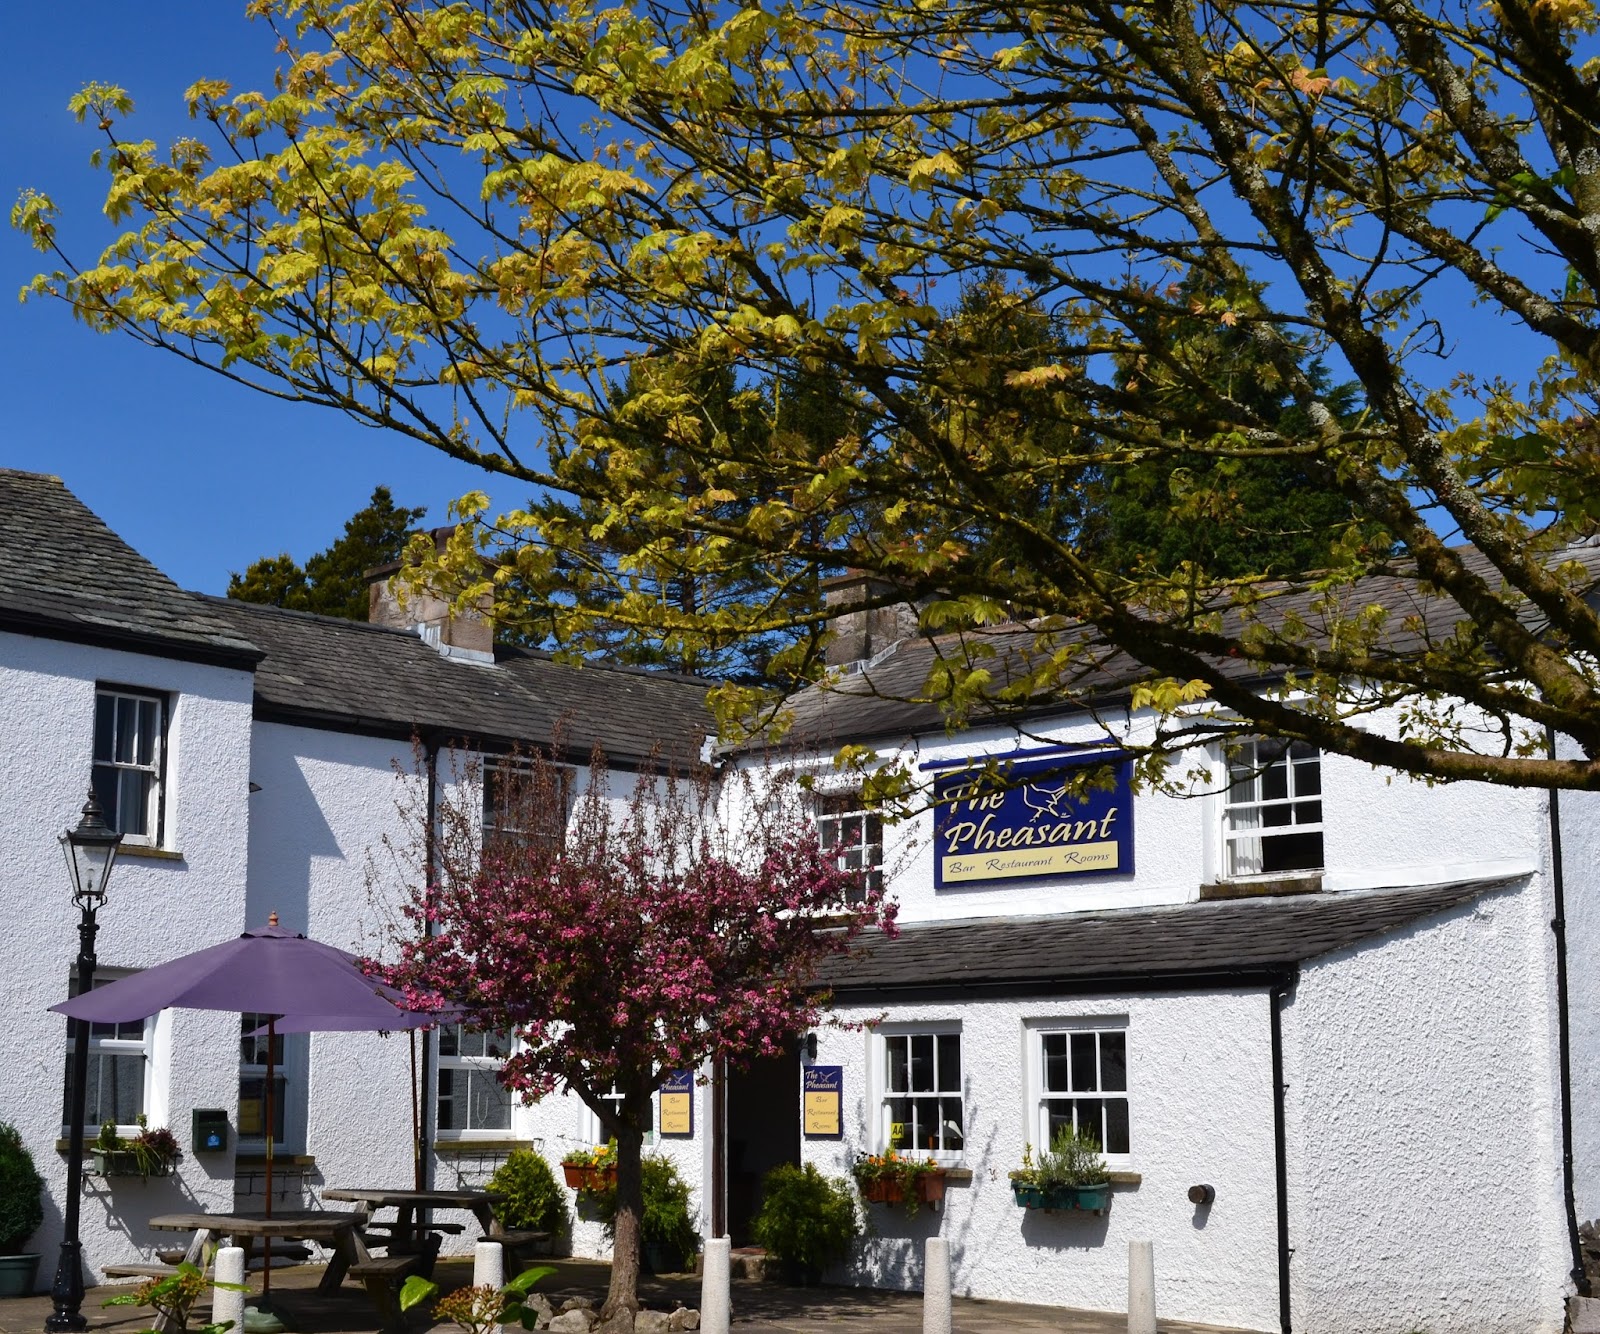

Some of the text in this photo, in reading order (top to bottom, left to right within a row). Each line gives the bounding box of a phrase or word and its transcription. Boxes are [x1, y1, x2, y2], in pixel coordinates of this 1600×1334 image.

[943, 782, 1004, 814] The
[944, 807, 1118, 853] Pheasant
[949, 851, 1110, 874] Bar Restaurant Rooms
[805, 1070, 818, 1079] The
[660, 1082, 689, 1090] Pheasant
[805, 1080, 838, 1089] Pheasant
[893, 1125, 903, 1135] AA
